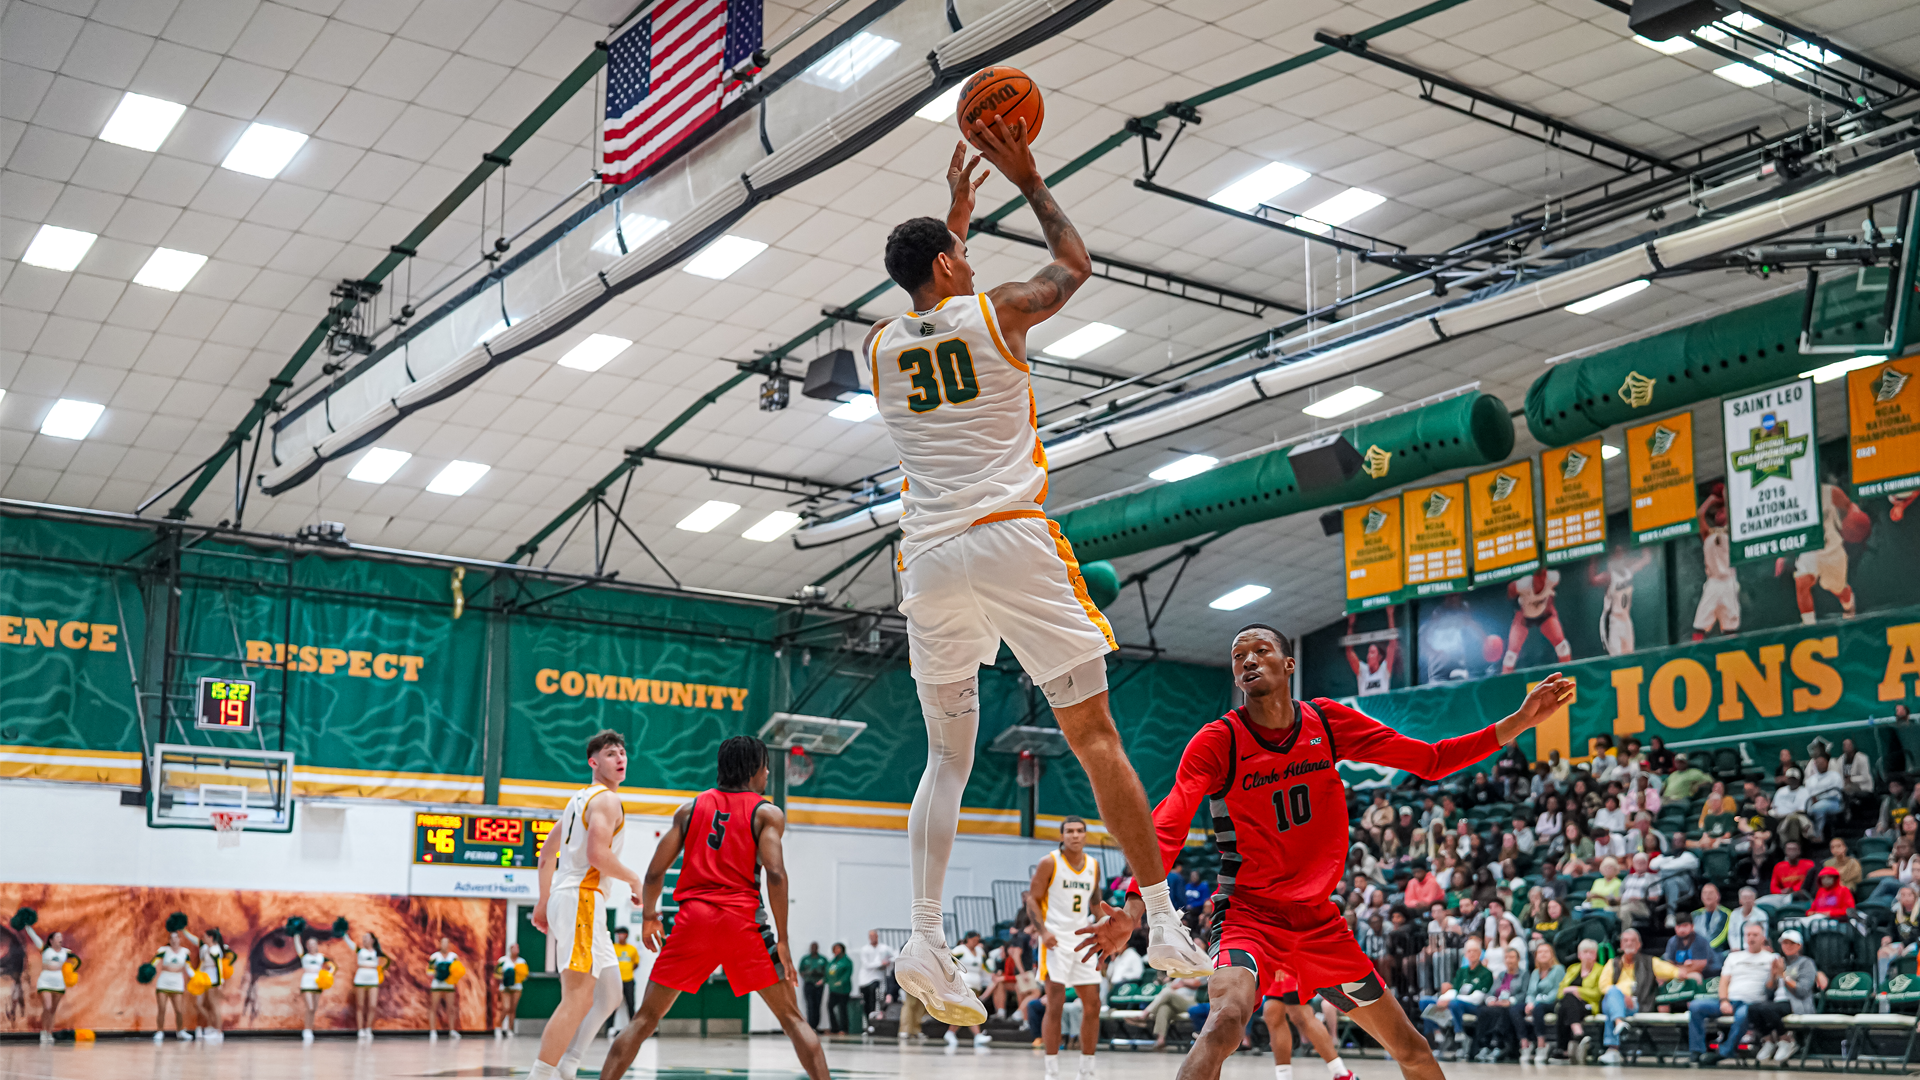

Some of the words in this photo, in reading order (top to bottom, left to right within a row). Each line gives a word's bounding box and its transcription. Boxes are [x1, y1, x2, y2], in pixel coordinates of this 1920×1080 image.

[966, 84, 1019, 124] Wilson
[897, 337, 981, 414] 30
[1733, 395, 1772, 416] SAINT
[1777, 386, 1803, 406] LEO
[1740, 510, 1808, 534] CHAMPIONS
[1746, 497, 1800, 519] NATIONAL
[1744, 541, 1777, 558] MEN'S
[1779, 533, 1807, 551] GOLF
[1417, 581, 1453, 595] SOFTBALL
[0, 615, 118, 652] ENCE
[245, 640, 424, 681] RESPECT
[535, 668, 749, 711] COMMUNITY
[1527, 636, 1844, 770] LIONS
[220, 699, 244, 726] 19
[1242, 768, 1280, 791] Clark
[1283, 758, 1331, 780] Atlanta
[1271, 783, 1312, 833] 10
[427, 829, 455, 853] 46
[475, 817, 522, 843] 15:22
[707, 809, 730, 850] 5
[464, 850, 498, 862] PERIOD
[501, 848, 513, 866] 2
[1063, 880, 1090, 891] LIONS
[1072, 894, 1082, 912] 2
